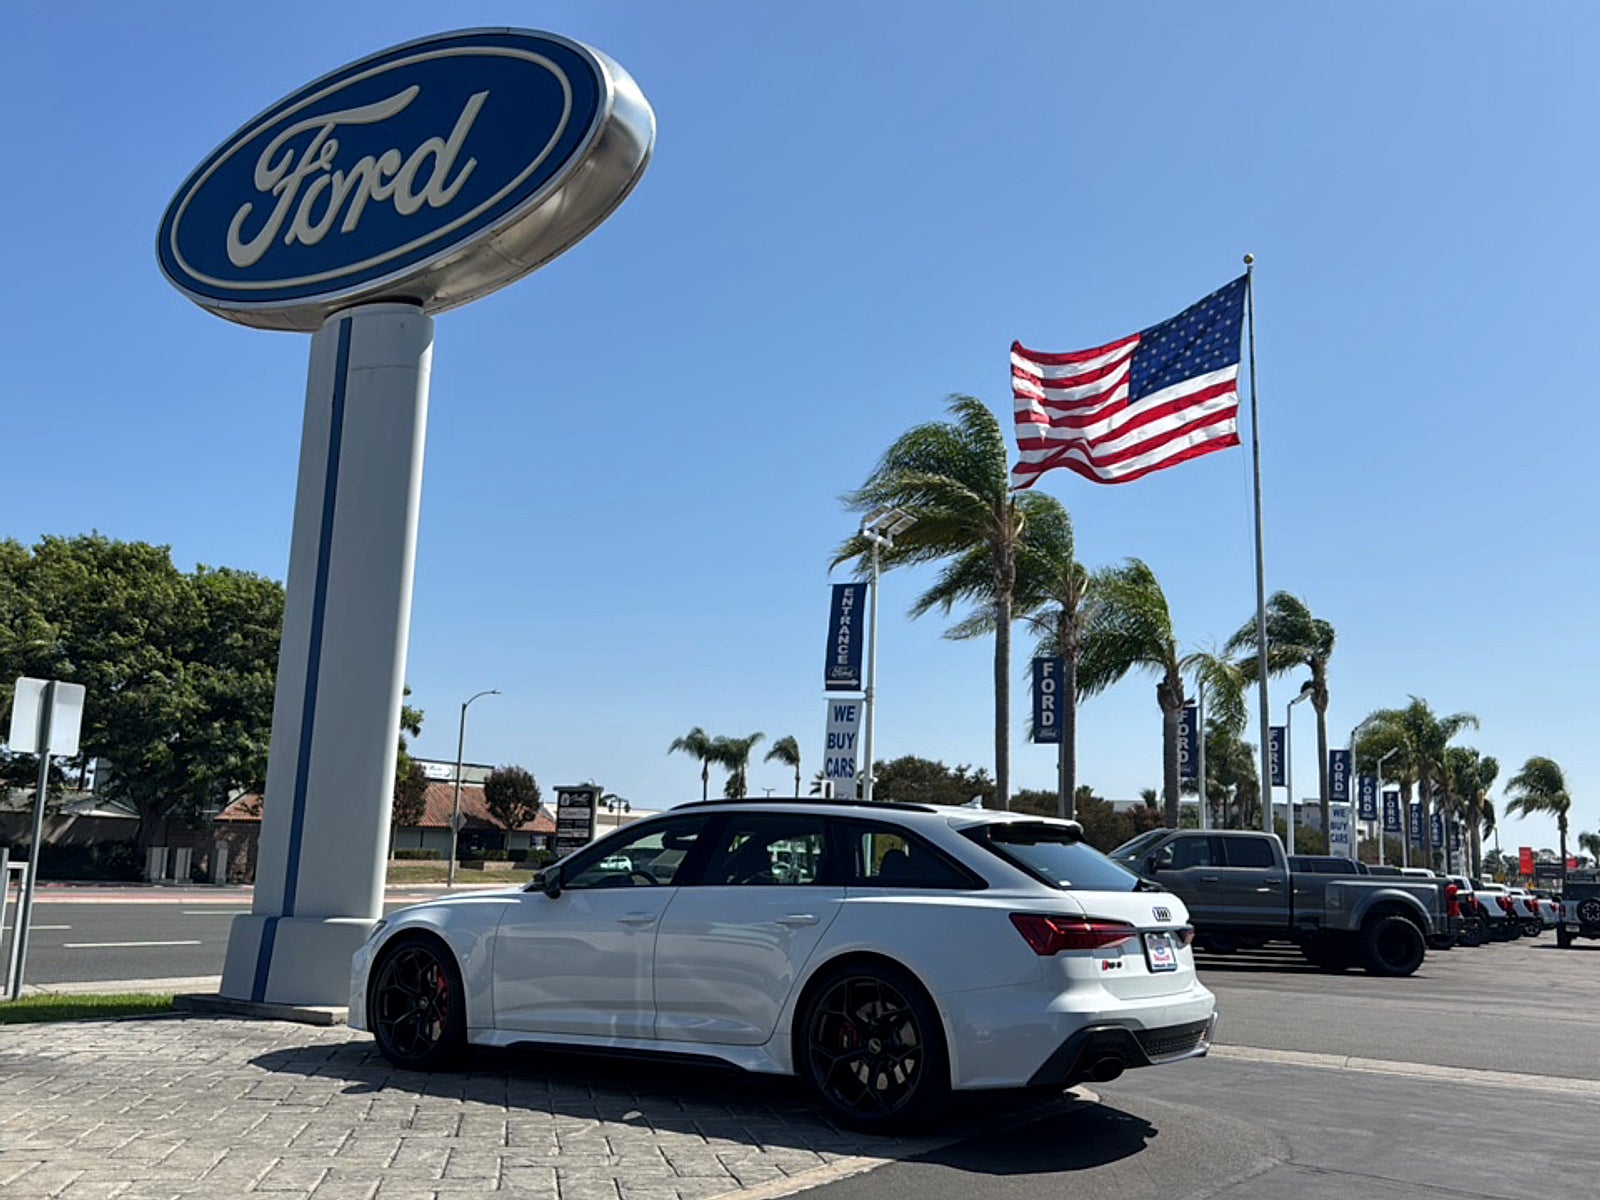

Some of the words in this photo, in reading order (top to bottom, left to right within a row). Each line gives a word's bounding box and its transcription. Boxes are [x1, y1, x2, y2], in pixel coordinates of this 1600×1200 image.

[226, 85, 490, 268] Ford
[837, 587, 855, 665] ENTRANCE
[834, 705, 856, 722] WE
[1041, 662, 1056, 727] FORD
[827, 732, 856, 750] BUY
[1178, 710, 1190, 763] FORD
[826, 757, 855, 778] CARS
[1334, 751, 1344, 792] FORD
[1363, 776, 1372, 812] FORD
